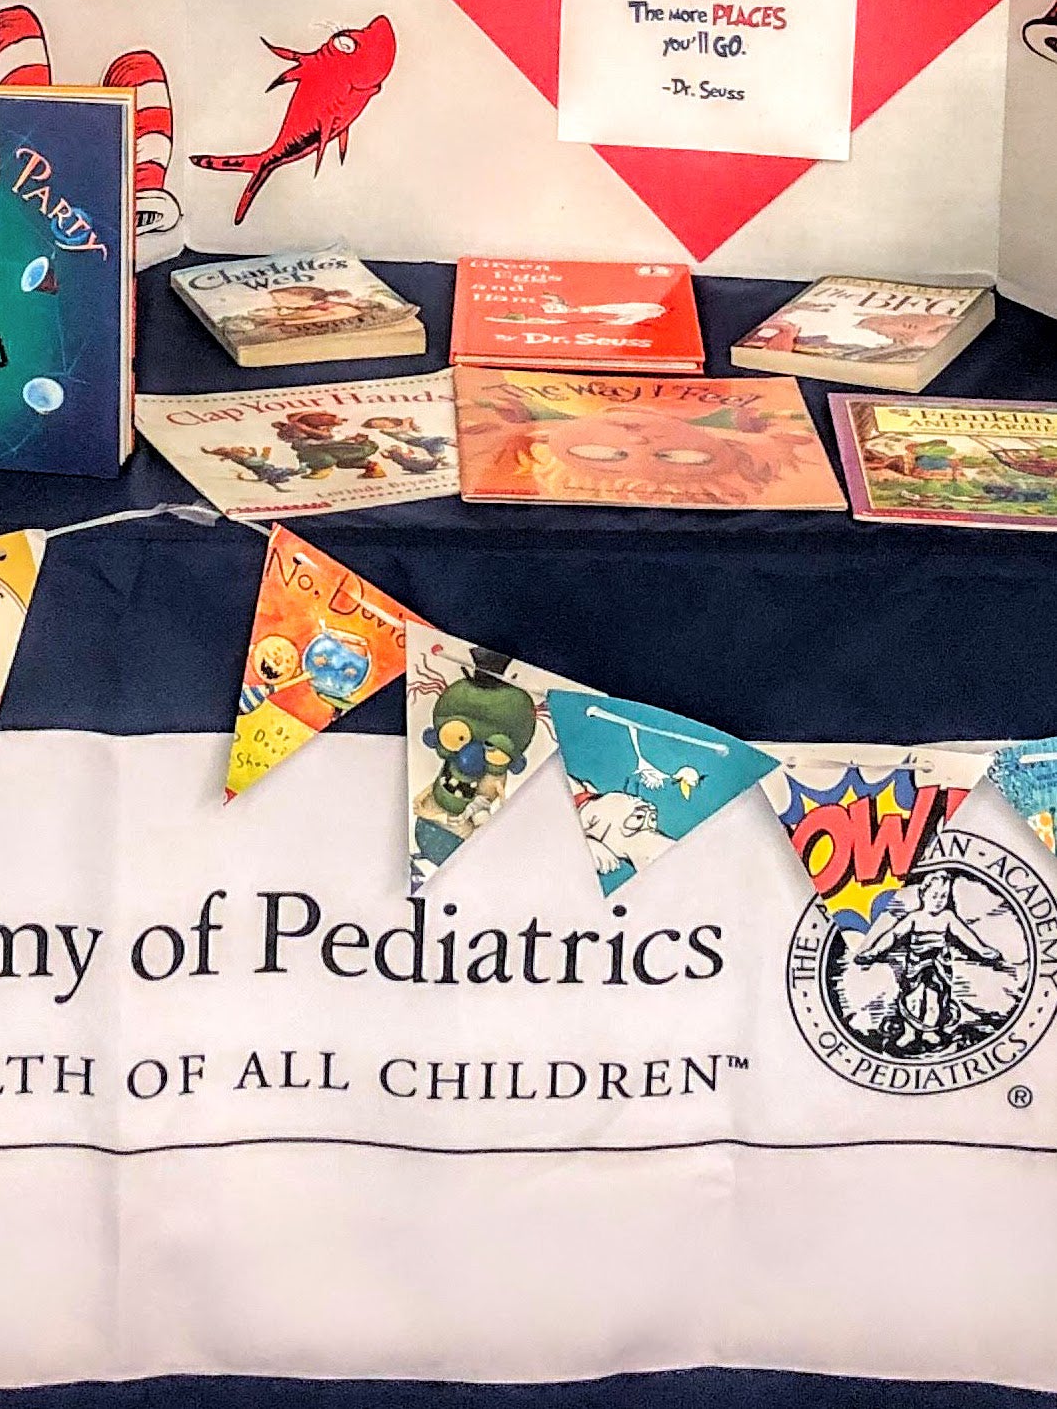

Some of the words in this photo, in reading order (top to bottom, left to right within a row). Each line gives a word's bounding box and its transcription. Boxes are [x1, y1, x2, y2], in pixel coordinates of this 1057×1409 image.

[628, 0, 665, 24] The
[712, 3, 788, 31] PLACES
[662, 30, 710, 58] you'll
[712, 34, 747, 58] GO.
[699, 80, 746, 101] Seuss
[189, 257, 348, 290] Charlotte's
[244, 271, 315, 292] Web
[857, 291, 966, 316] BFG
[574, 332, 654, 348] Seuss
[166, 408, 244, 426] Clap
[244, 394, 331, 415] Your
[332, 390, 456, 407] Hands
[565, 380, 645, 404] Way
[678, 384, 762, 409] Feel
[919, 410, 1054, 425] Franklin
[130, 888, 228, 982] of
[254, 890, 725, 986] Pediatrics
[792, 935, 821, 990] THE
[126, 1053, 207, 1101] OF
[233, 1049, 350, 1092] ALL
[852, 1031, 1029, 1089] PEDIATRICS
